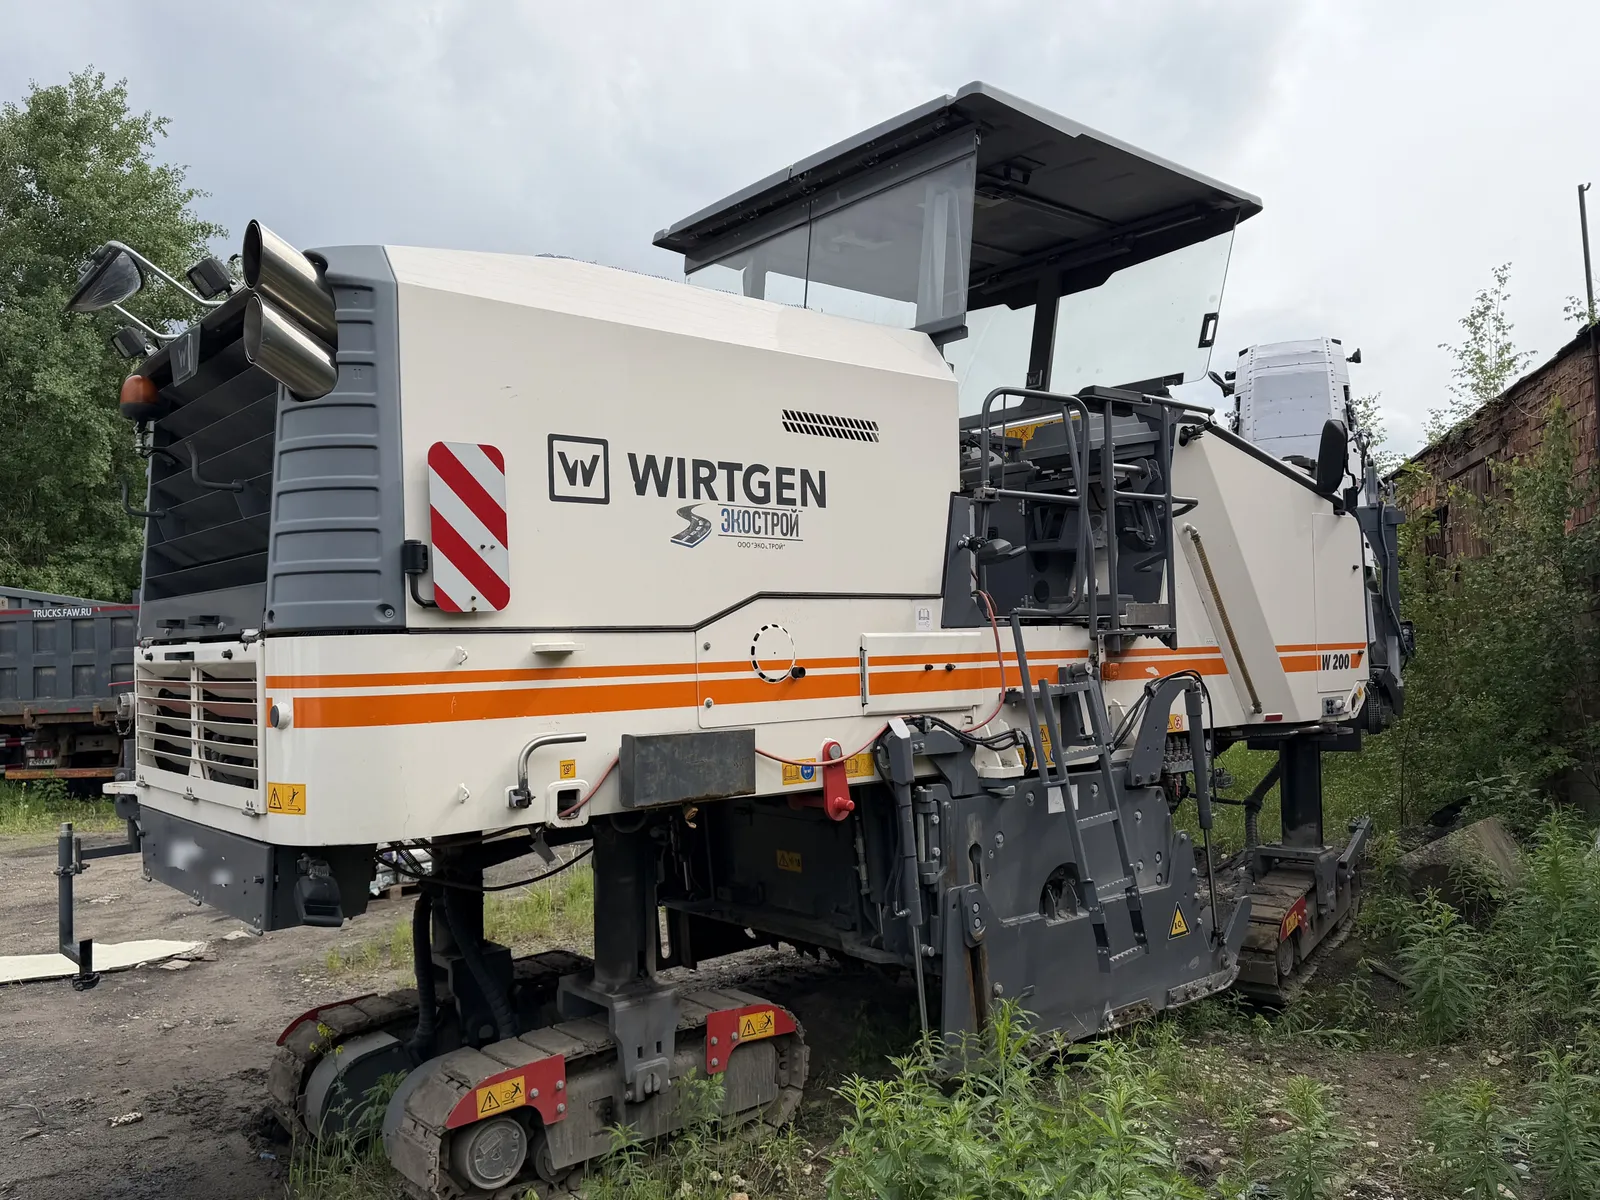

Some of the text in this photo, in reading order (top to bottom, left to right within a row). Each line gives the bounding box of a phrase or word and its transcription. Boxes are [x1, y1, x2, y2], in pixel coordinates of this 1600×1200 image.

[557, 451, 600, 487] W
[627, 452, 827, 509] WIRTGEN
[720, 507, 800, 538] ЭКОСТРОЙ
[32, 607, 92, 618] TRUCKS.FAW.RU
[1322, 653, 1350, 670] W 200
